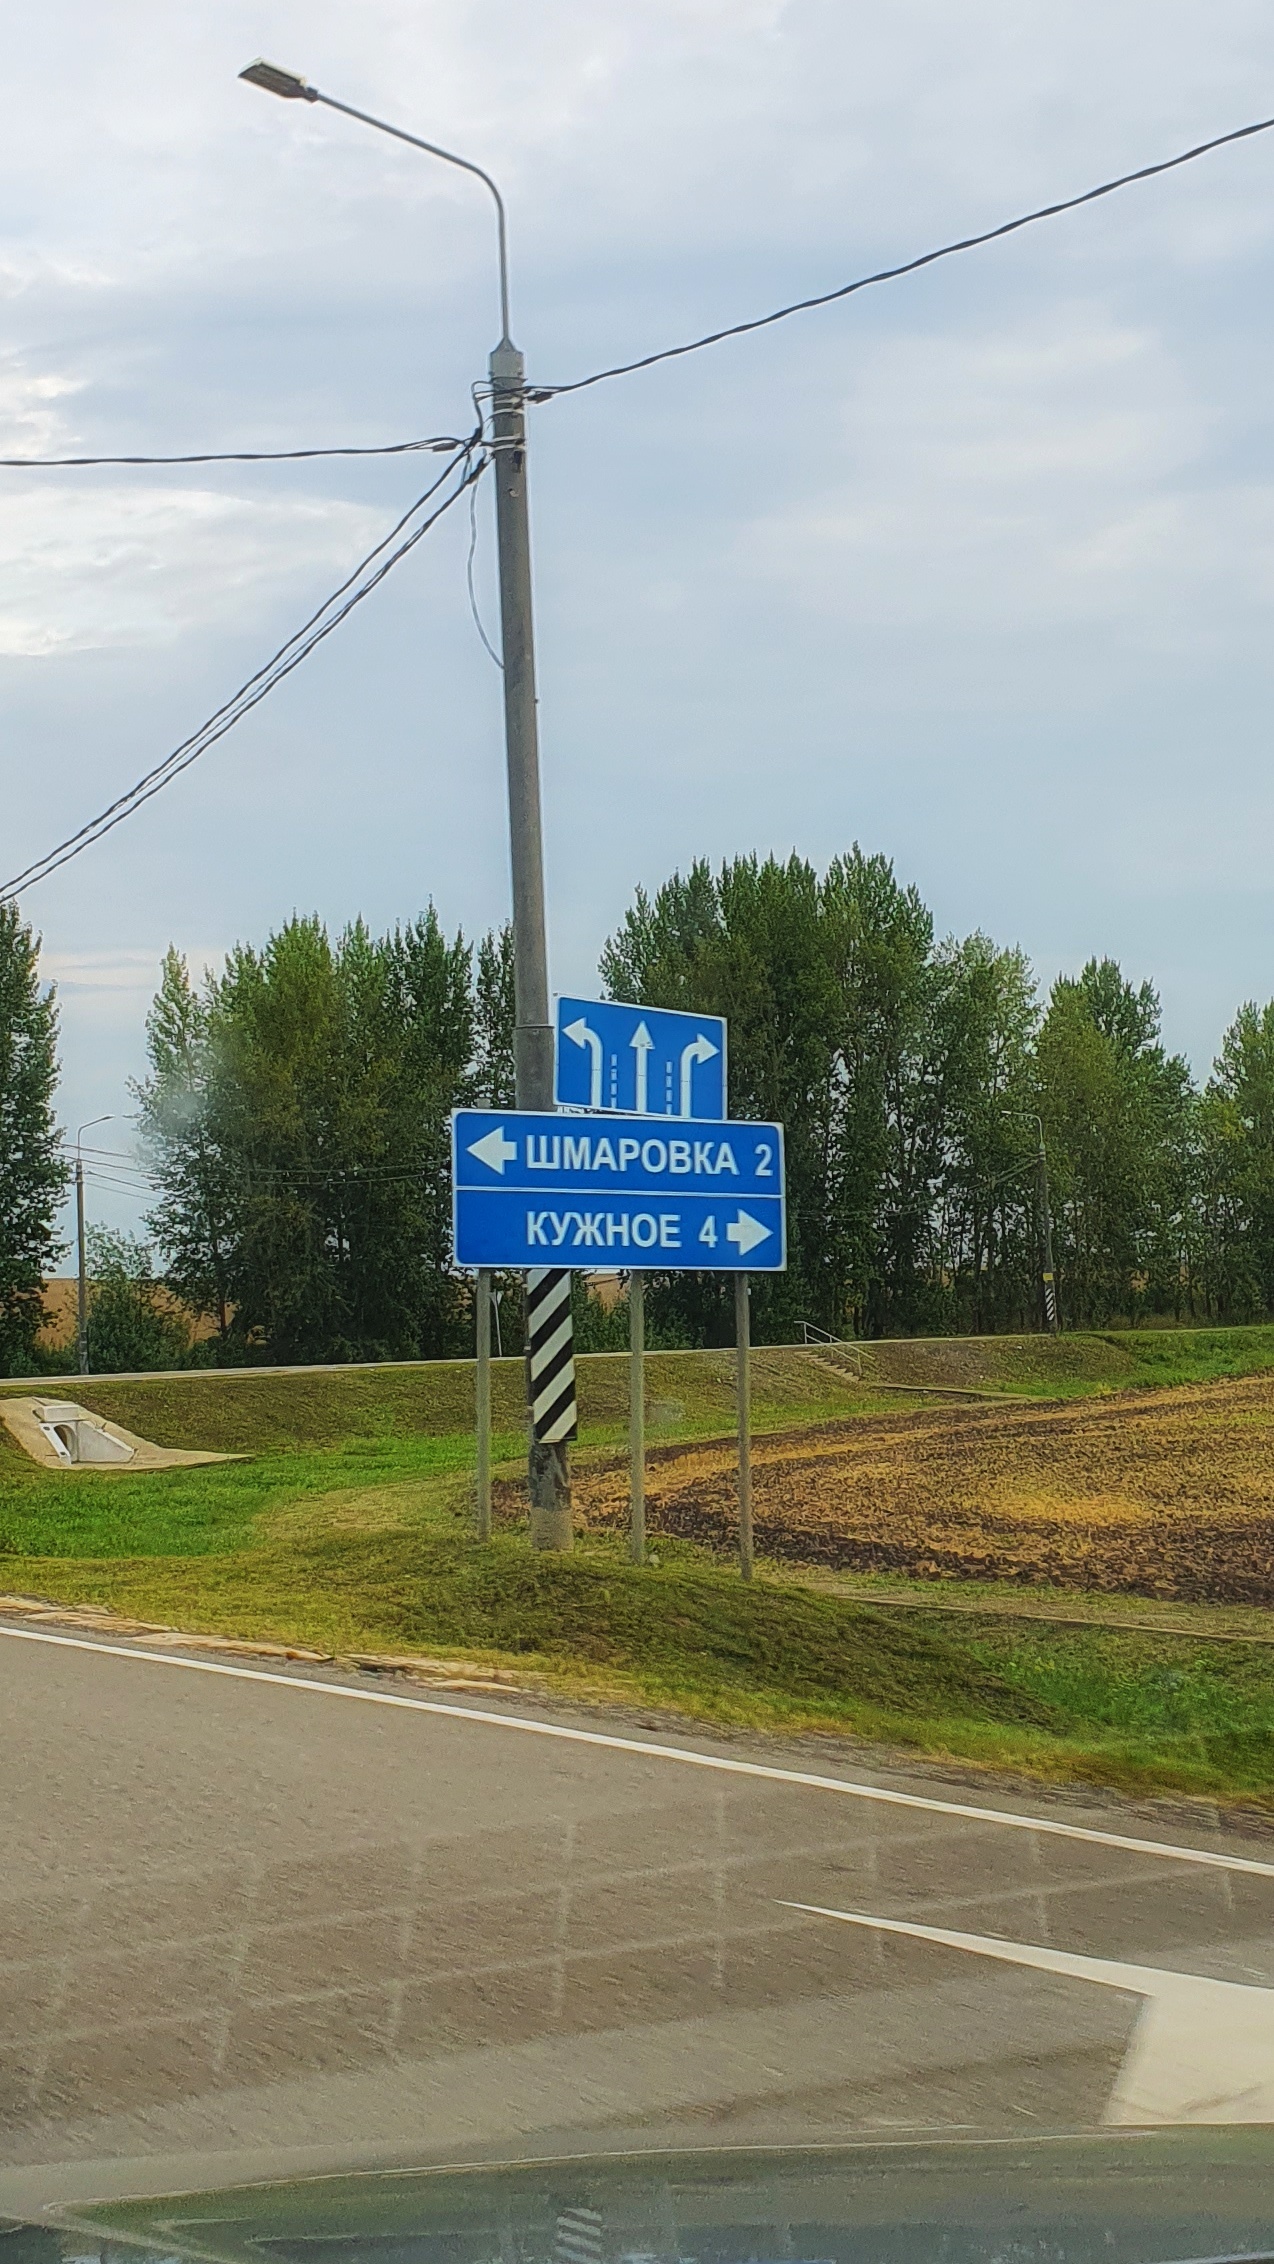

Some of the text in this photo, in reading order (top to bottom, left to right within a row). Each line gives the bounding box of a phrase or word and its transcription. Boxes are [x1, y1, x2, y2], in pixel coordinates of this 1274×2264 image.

[526, 1134, 773, 1176] ШМАРОВКА 2
[526, 1211, 718, 1248] КУЖНОЕ 4
